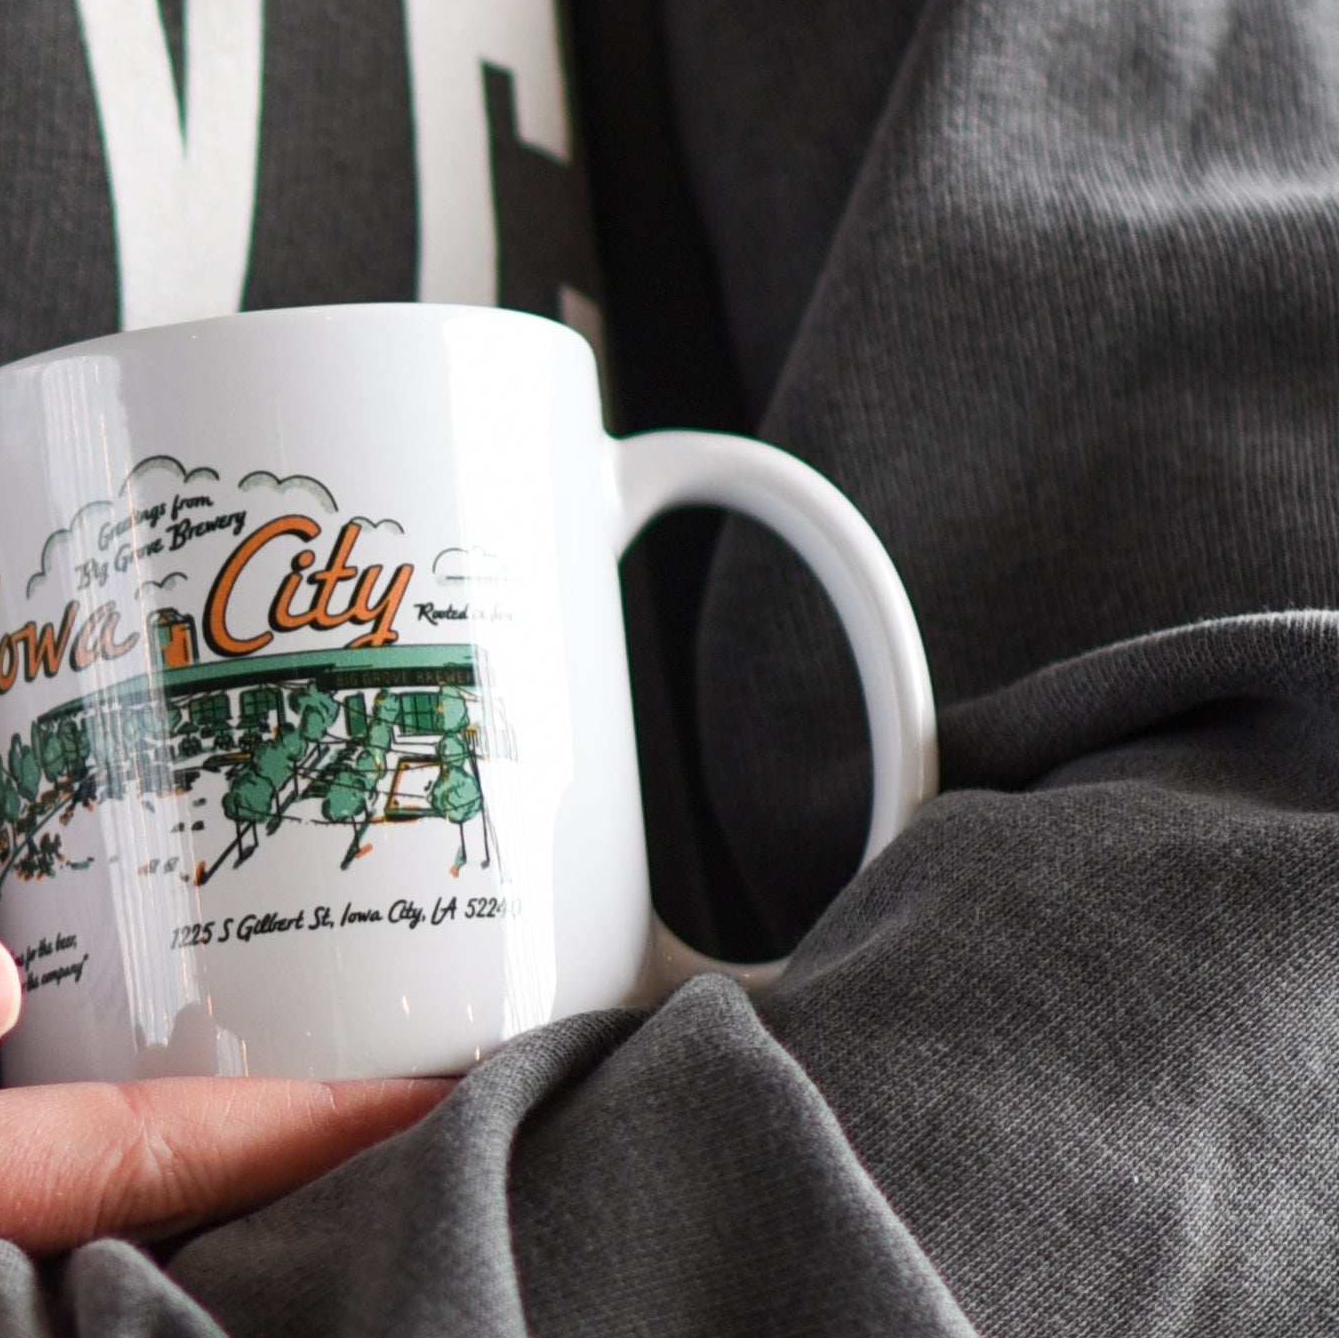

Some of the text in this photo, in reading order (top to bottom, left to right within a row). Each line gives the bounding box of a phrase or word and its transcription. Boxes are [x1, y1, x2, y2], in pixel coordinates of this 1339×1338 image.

[170, 494, 214, 521] from
[165, 510, 247, 551] Brewery
[202, 513, 415, 660] City
[414, 601, 470, 626] Rooted
[170, 921, 215, 949] 1225
[218, 917, 234, 942] S
[237, 910, 305, 942] Gilbert
[308, 906, 334, 930] St,
[340, 902, 383, 927] Iowa
[388, 899, 426, 930] City,
